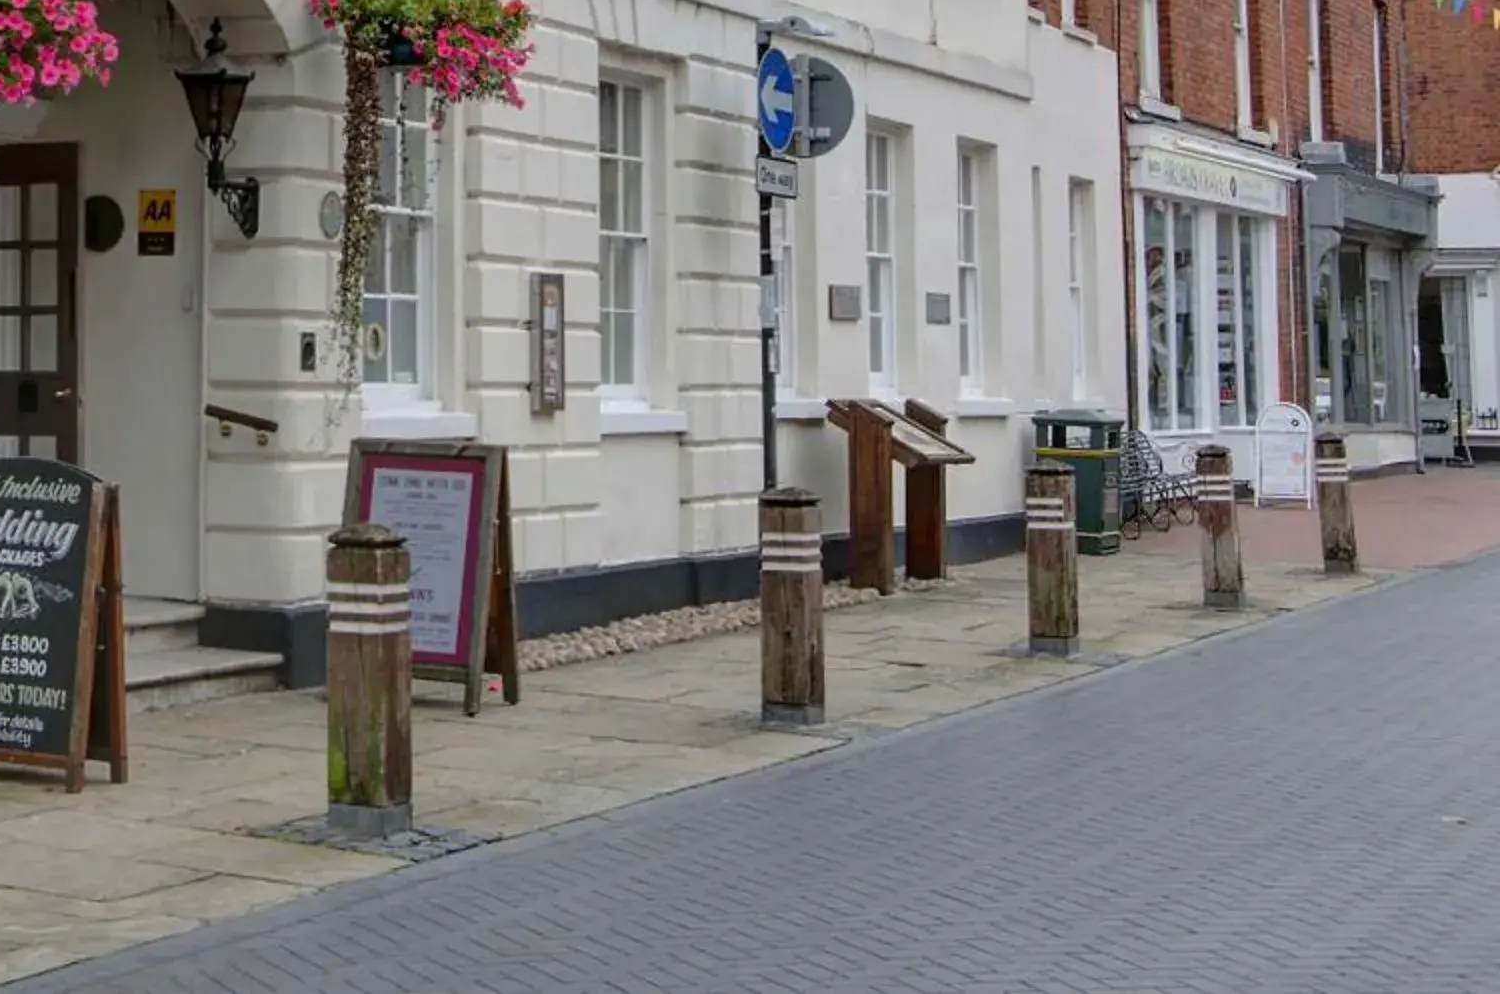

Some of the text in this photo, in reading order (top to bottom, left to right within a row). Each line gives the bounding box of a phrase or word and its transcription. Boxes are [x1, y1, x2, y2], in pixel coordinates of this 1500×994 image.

[144, 199, 171, 222] AA
[2, 634, 49, 654] £3800
[0, 656, 47, 676] £3900
[17, 684, 67, 710] TODAY!
